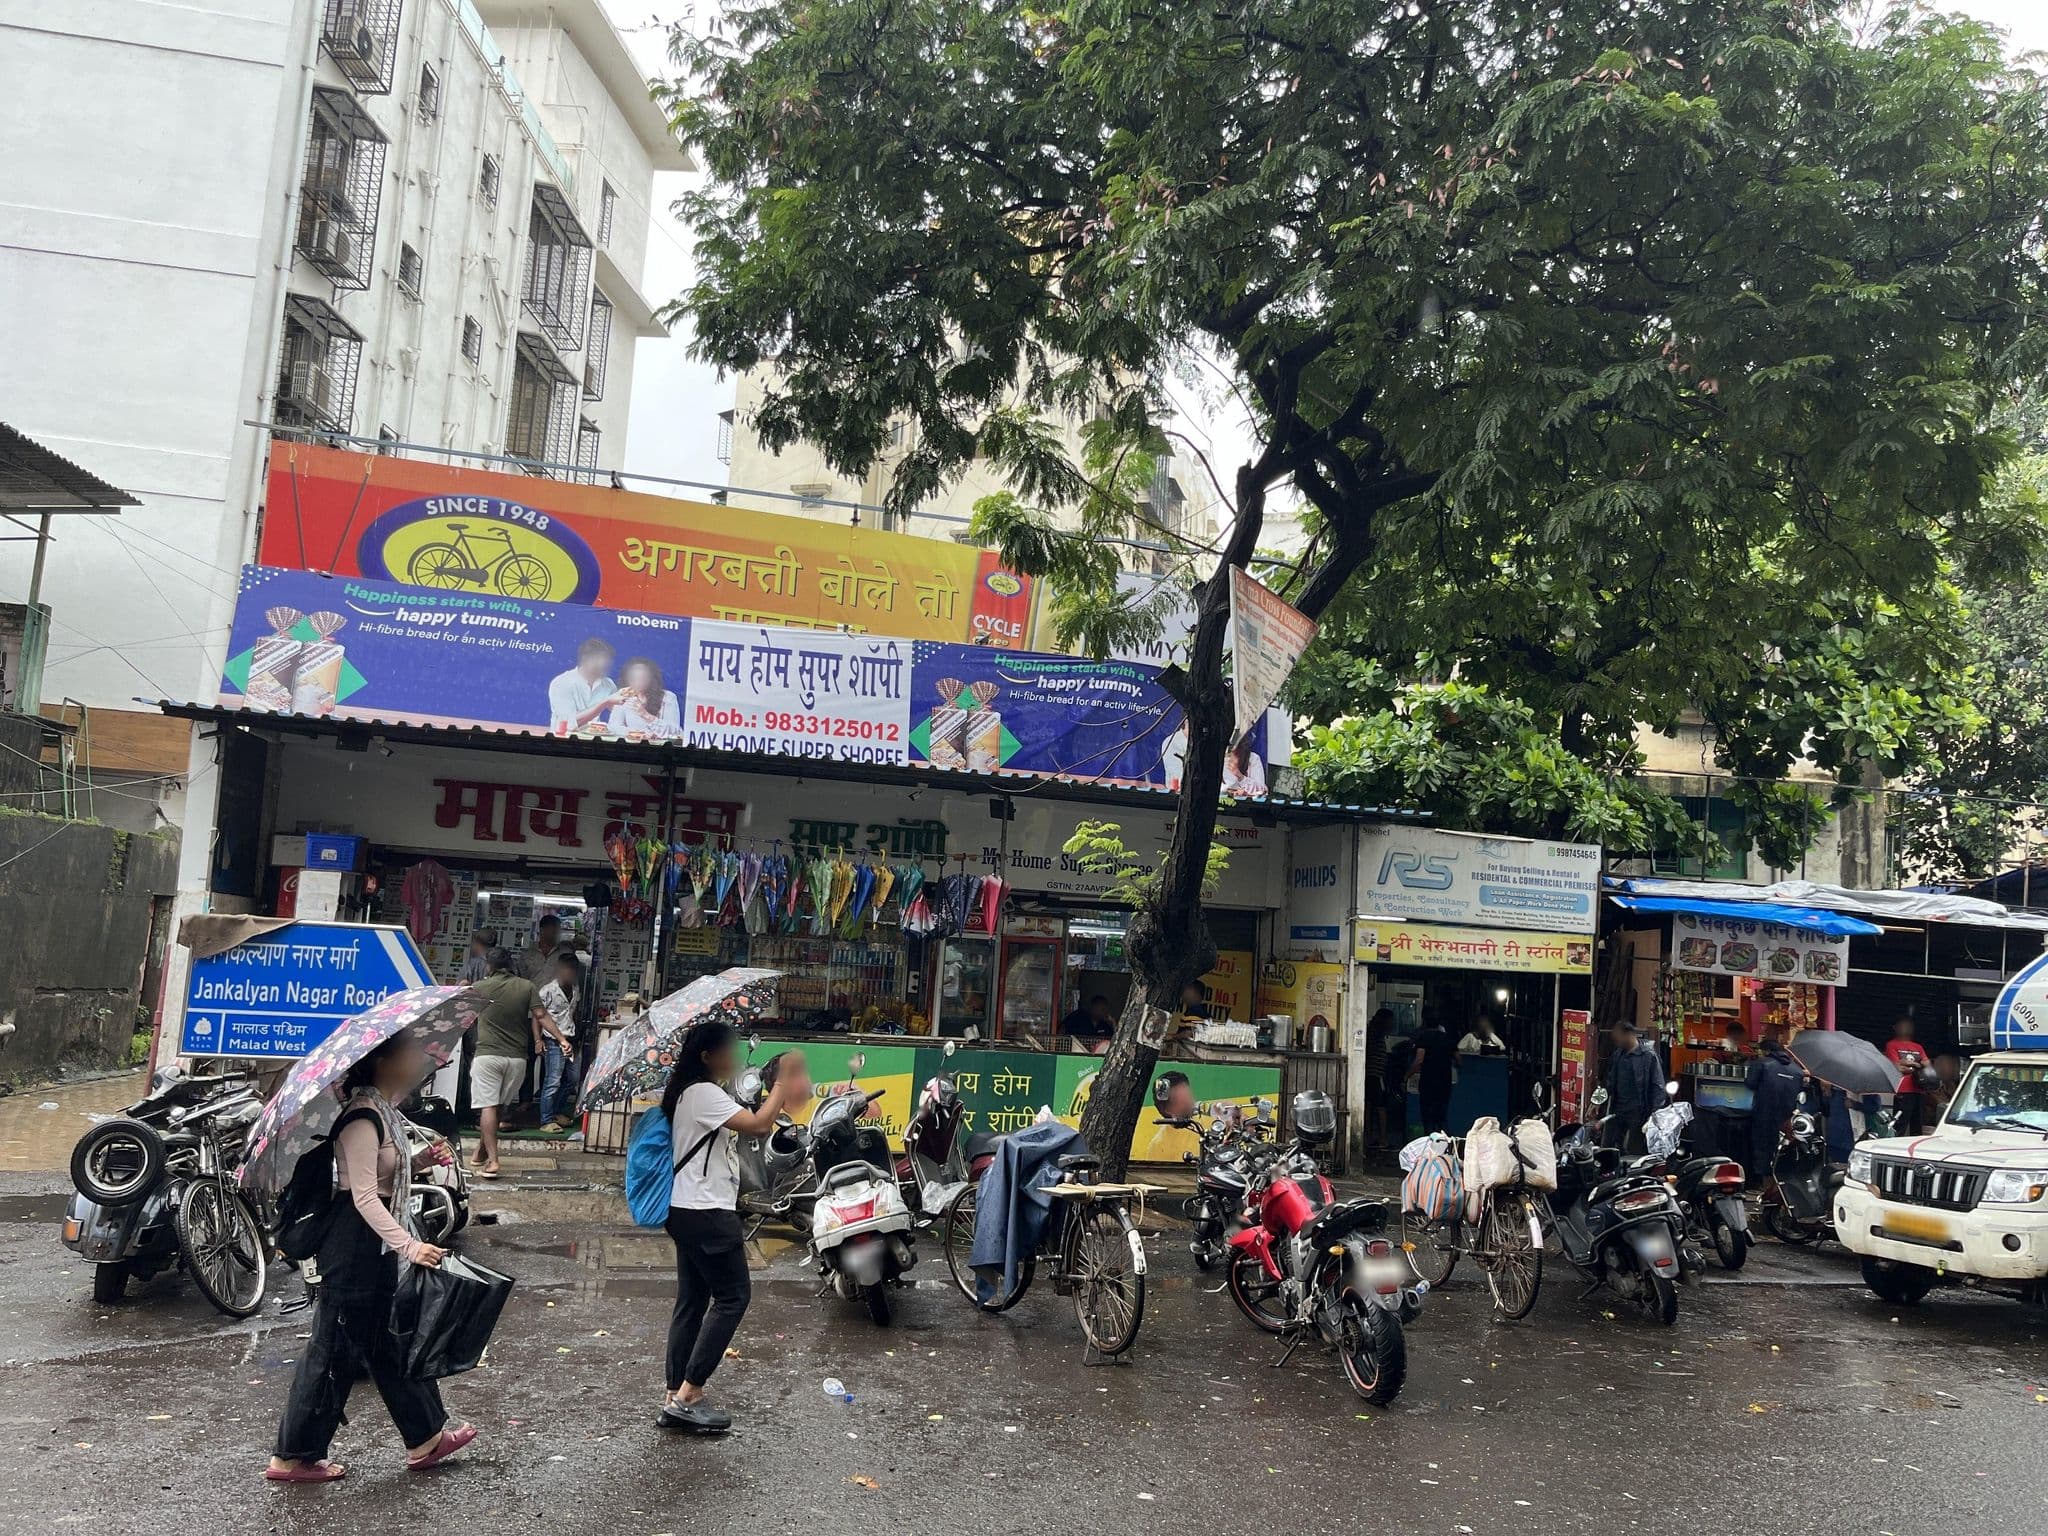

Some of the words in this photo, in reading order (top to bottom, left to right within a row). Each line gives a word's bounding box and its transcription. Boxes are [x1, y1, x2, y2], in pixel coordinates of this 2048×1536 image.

[426, 498, 489, 515] SINCE
[499, 502, 550, 531] 1948
[618, 537, 805, 598] अगरबत्ती
[816, 554, 900, 612] बोले
[913, 568, 960, 621] तो
[343, 583, 438, 606] Happiness
[439, 596, 486, 609] starts
[488, 599, 521, 615] with
[524, 607, 534, 618] a
[395, 607, 457, 627] happy
[460, 611, 530, 634] tummy.
[616, 614, 679, 630] modern
[972, 614, 1021, 638] CYCLE
[358, 622, 404, 636] Hi-fibre
[406, 626, 441, 640] bread
[442, 628, 460, 642] for
[461, 634, 476, 645] an
[478, 635, 508, 649] activ
[508, 636, 555, 654] lifestyle.
[700, 640, 745, 684] माय
[750, 628, 793, 695] होम
[799, 650, 844, 710] सुपर
[849, 640, 904, 699] शॉपी
[994, 654, 1069, 674] Happiness
[1071, 663, 1107, 674] starts
[1110, 666, 1136, 680] with
[1138, 673, 1146, 682] a
[1038, 675, 1086, 692] happy
[1088, 676, 1144, 697] tummy.
[1009, 690, 1045, 702] Hi-fibre
[1046, 693, 1074, 704] bread
[1076, 694, 1089, 706] for
[1090, 698, 1103, 708] an
[1104, 698, 1127, 710] activ
[1128, 700, 1163, 716] lifestyle.
[696, 704, 757, 728] Mob.:
[764, 711, 900, 742] 9833125012
[688, 730, 718, 748] MY
[722, 734, 777, 754] HOME
[782, 739, 835, 760] SUPER
[840, 744, 904, 765] SHOPEE
[433, 778, 590, 848] माय
[866, 816, 950, 861] शॉपी
[1010, 850, 1051, 870] Home
[1376, 845, 1460, 891] RS
[1556, 847, 1597, 860] 9987454645
[1294, 864, 1336, 888] PHILIPS
[1488, 863, 1498, 871] For
[1500, 864, 1522, 874] Buying
[1522, 866, 1545, 877] Selling
[1552, 869, 1572, 878] Rental
[1512, 876, 1518, 884] &
[1518, 876, 1563, 888] COMMERCIAL
[1564, 880, 1598, 891] PREMISES
[1374, 902, 1382, 912] &
[204, 943, 290, 968] कल्याण
[292, 944, 327, 969] नगर
[330, 938, 360, 970] मार्ग
[1390, 932, 1413, 951] श्री
[1418, 934, 1498, 957] भेरुभवानी
[1503, 940, 1520, 958] टी
[1526, 941, 1565, 961] स्टॉल
[194, 976, 280, 1006] Jankalyan
[286, 980, 338, 1009] Nagar
[344, 983, 388, 1006] Road
[232, 1022, 271, 1035] मालाड
[272, 1021, 308, 1036] पश्चिम
[2012, 1002, 2040, 1032] GOODS
[228, 1038, 270, 1050] Malad
[274, 1040, 306, 1052] West
[956, 1072, 981, 1094] ाय
[992, 1066, 1033, 1096] होम
